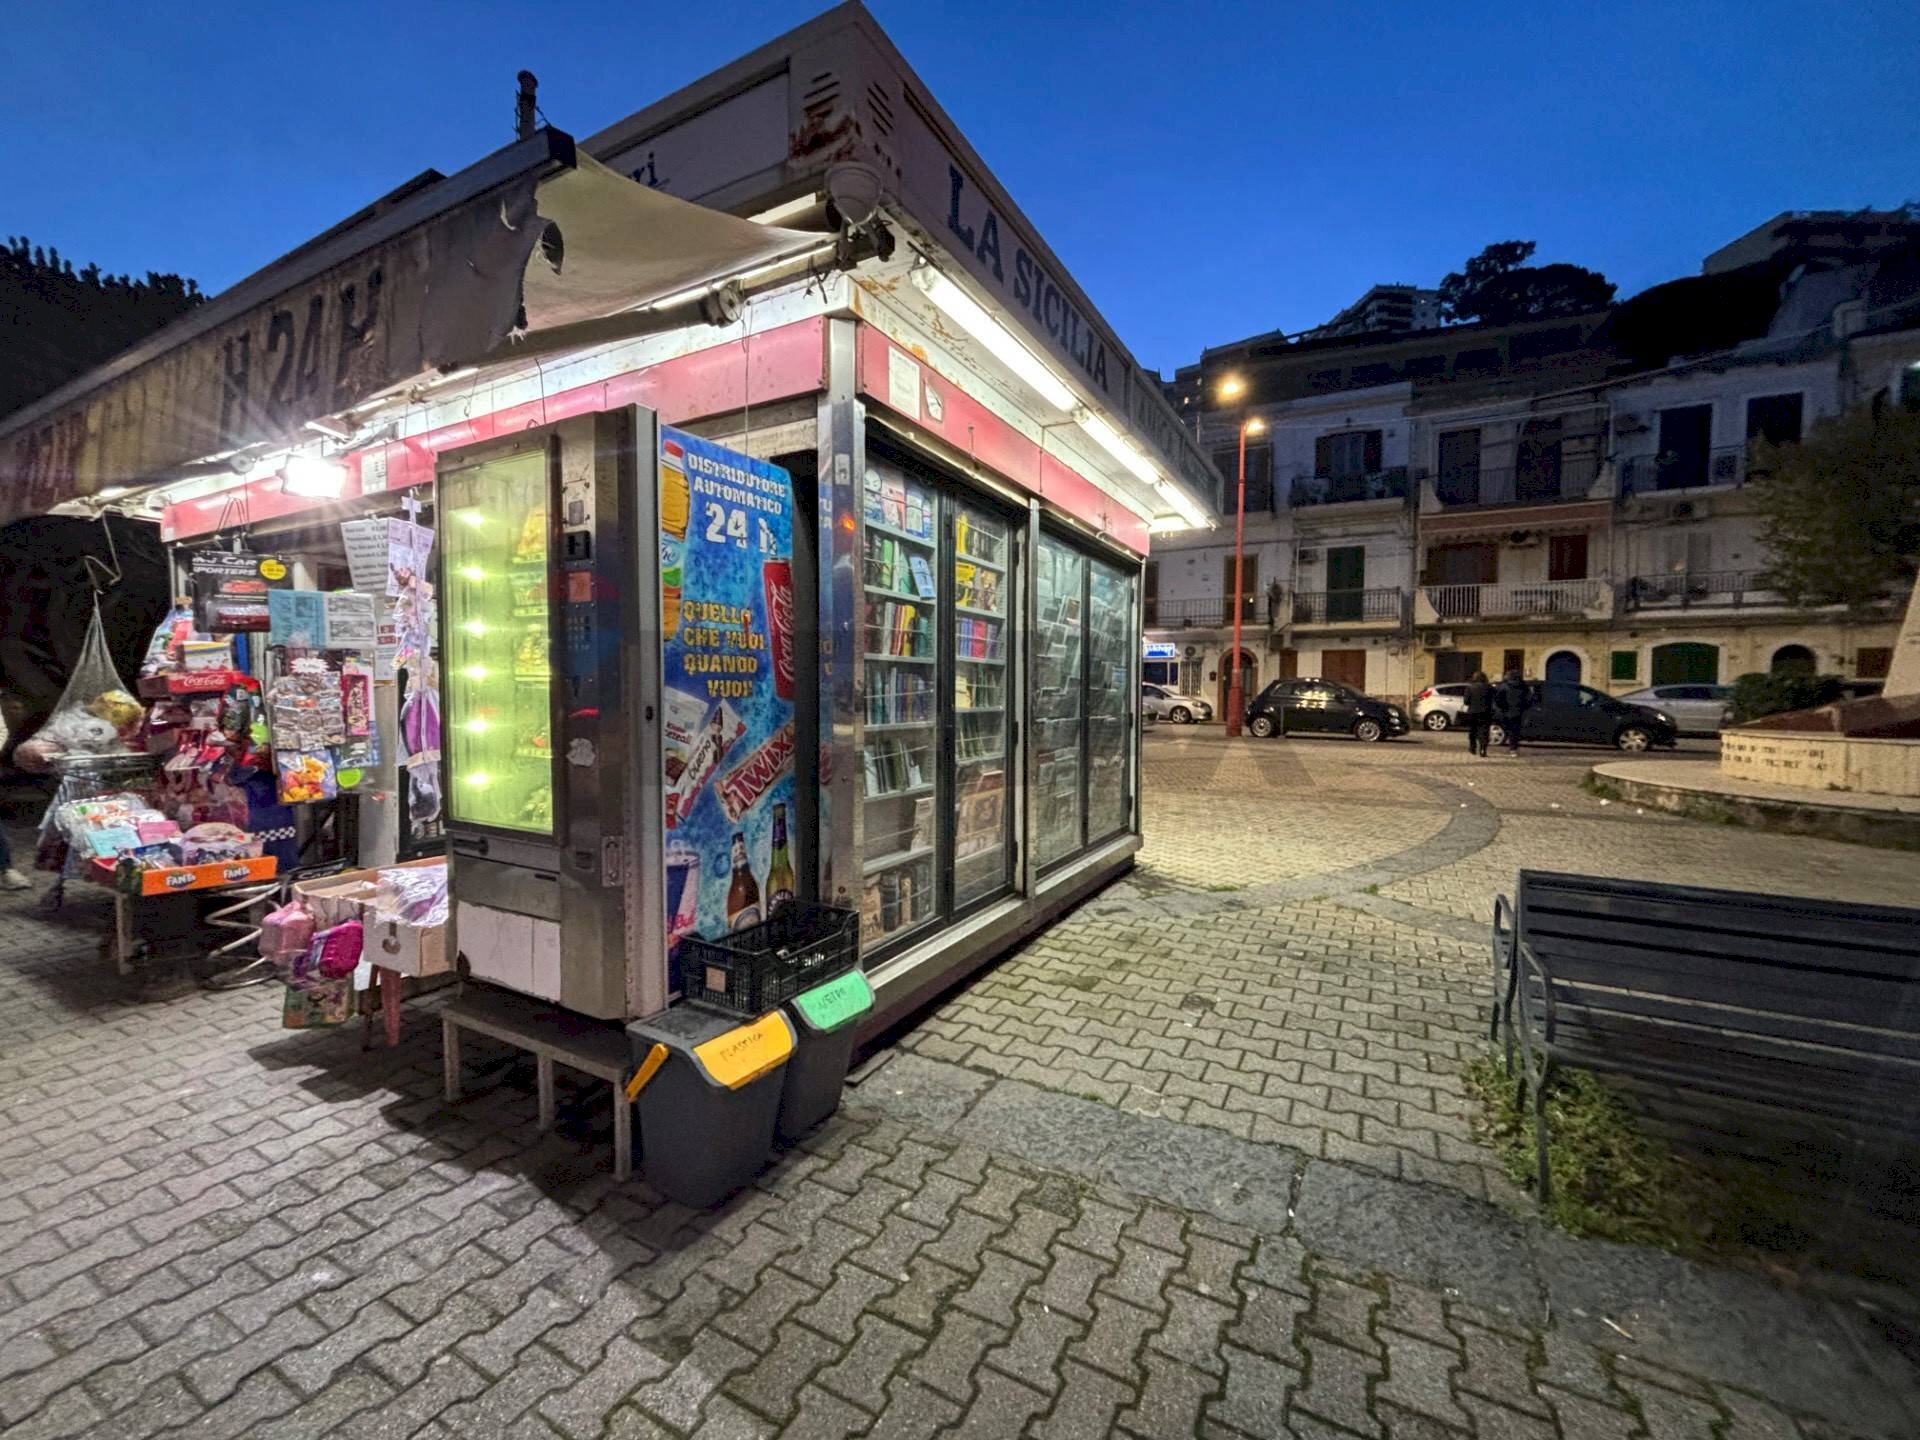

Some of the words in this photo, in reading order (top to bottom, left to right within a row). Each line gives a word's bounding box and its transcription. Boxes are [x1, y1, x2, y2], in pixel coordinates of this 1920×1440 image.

[947, 164, 1004, 286] LA
[1013, 247, 1109, 393] SICILIA
[687, 452, 786, 498] DISTRIBUTORE
[693, 476, 782, 516] AUTOMATICO
[705, 502, 748, 550] 24
[222, 556, 258, 566] CAR
[683, 600, 753, 624] QUELLO
[683, 627, 720, 648] CHE
[725, 629, 765, 650] VUOI
[683, 653, 758, 675] QUANDO
[688, 739, 712, 780] bueno
